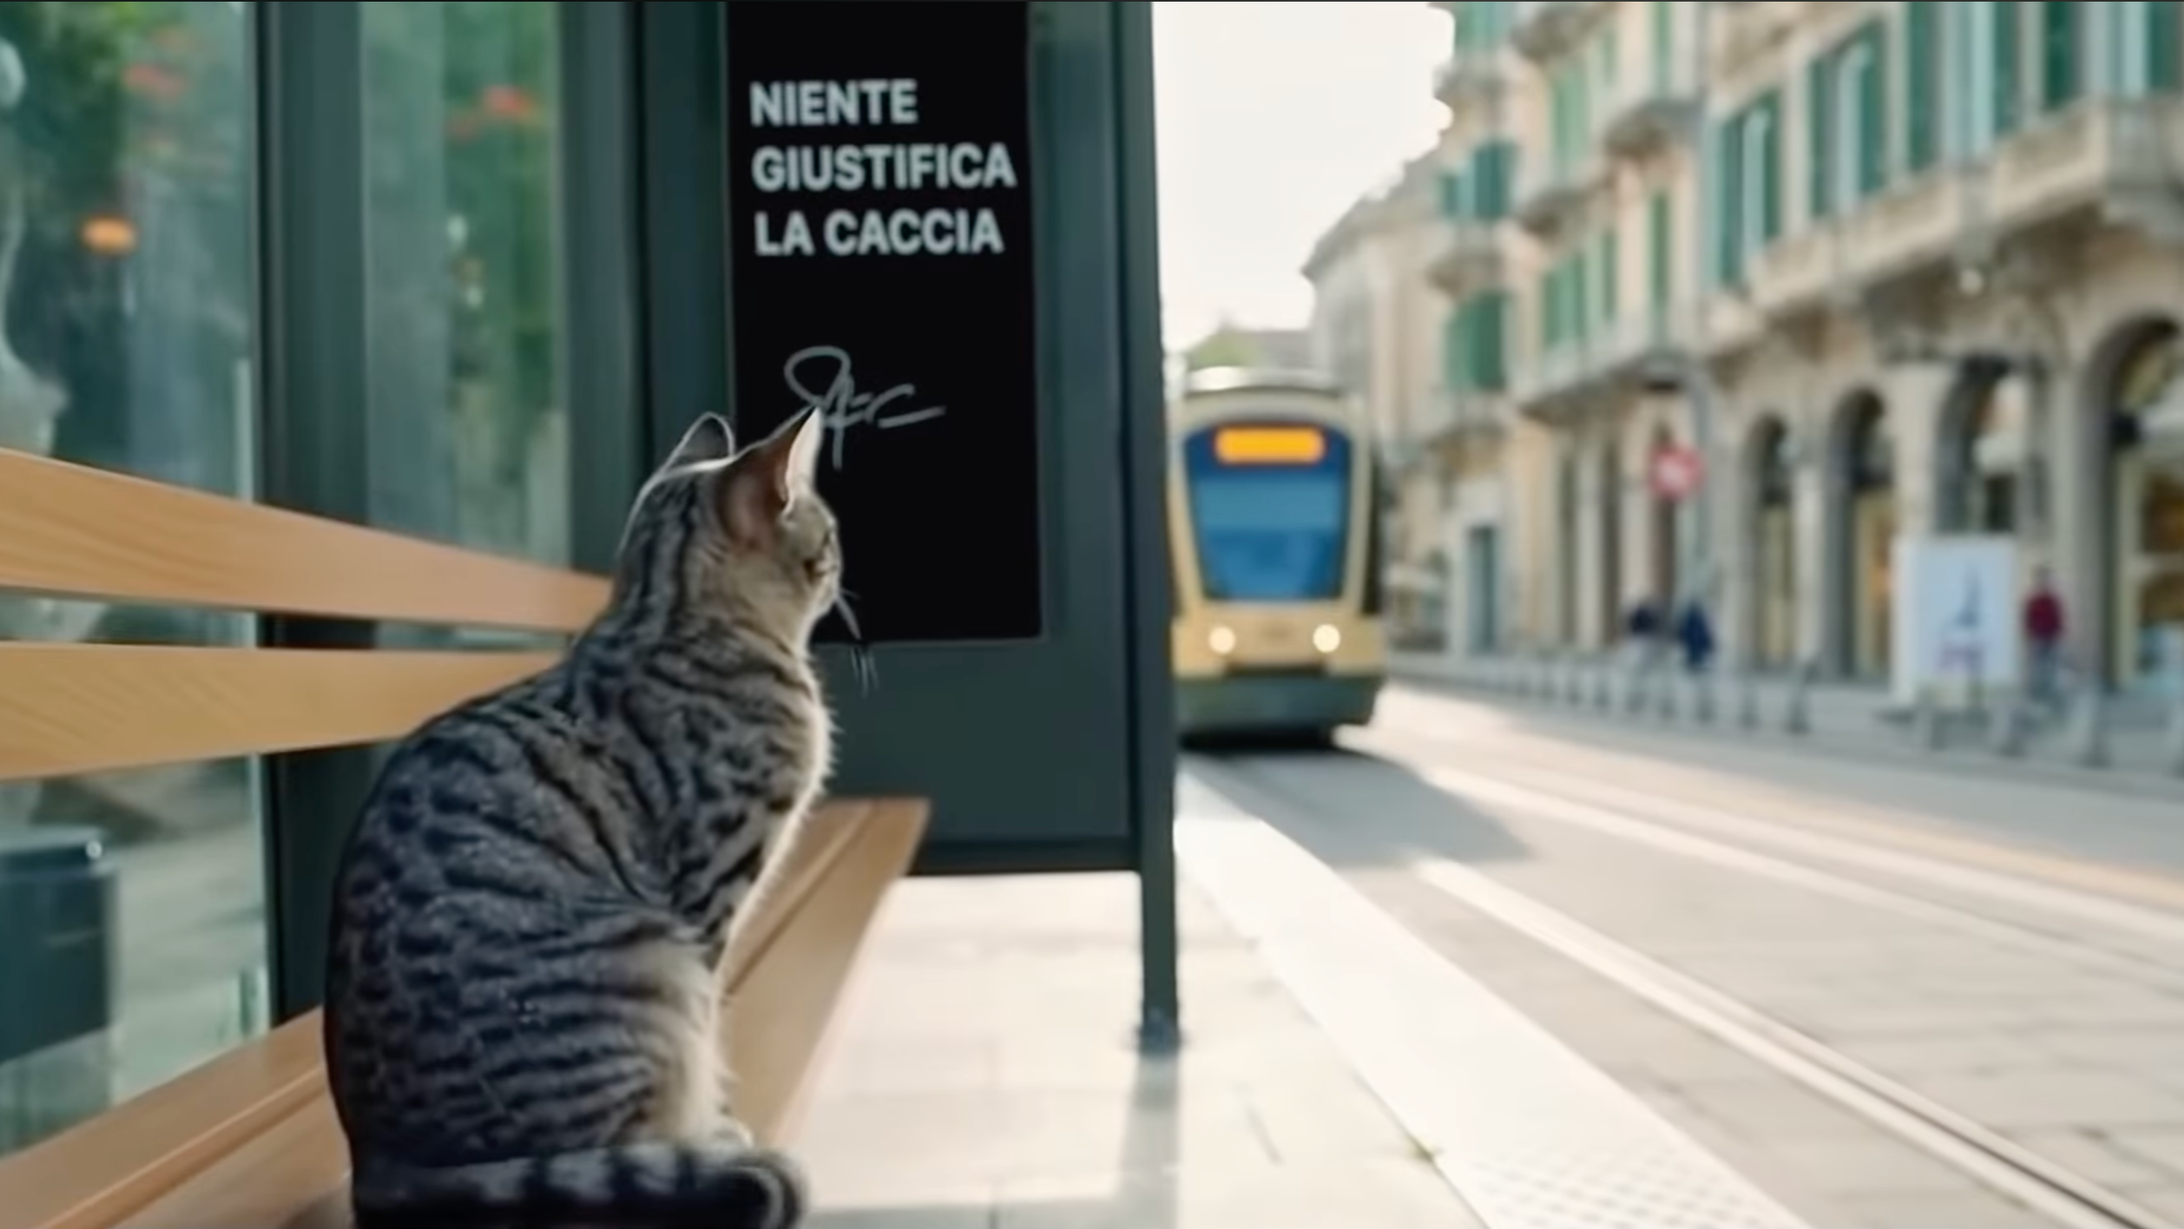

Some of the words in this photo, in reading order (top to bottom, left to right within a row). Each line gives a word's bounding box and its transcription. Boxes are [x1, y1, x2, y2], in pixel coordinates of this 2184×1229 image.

[750, 79, 919, 126] NIENTE
[751, 143, 1017, 191] GIUSTIFICA
[755, 211, 814, 256] LA
[823, 209, 1005, 255] CACCIA
